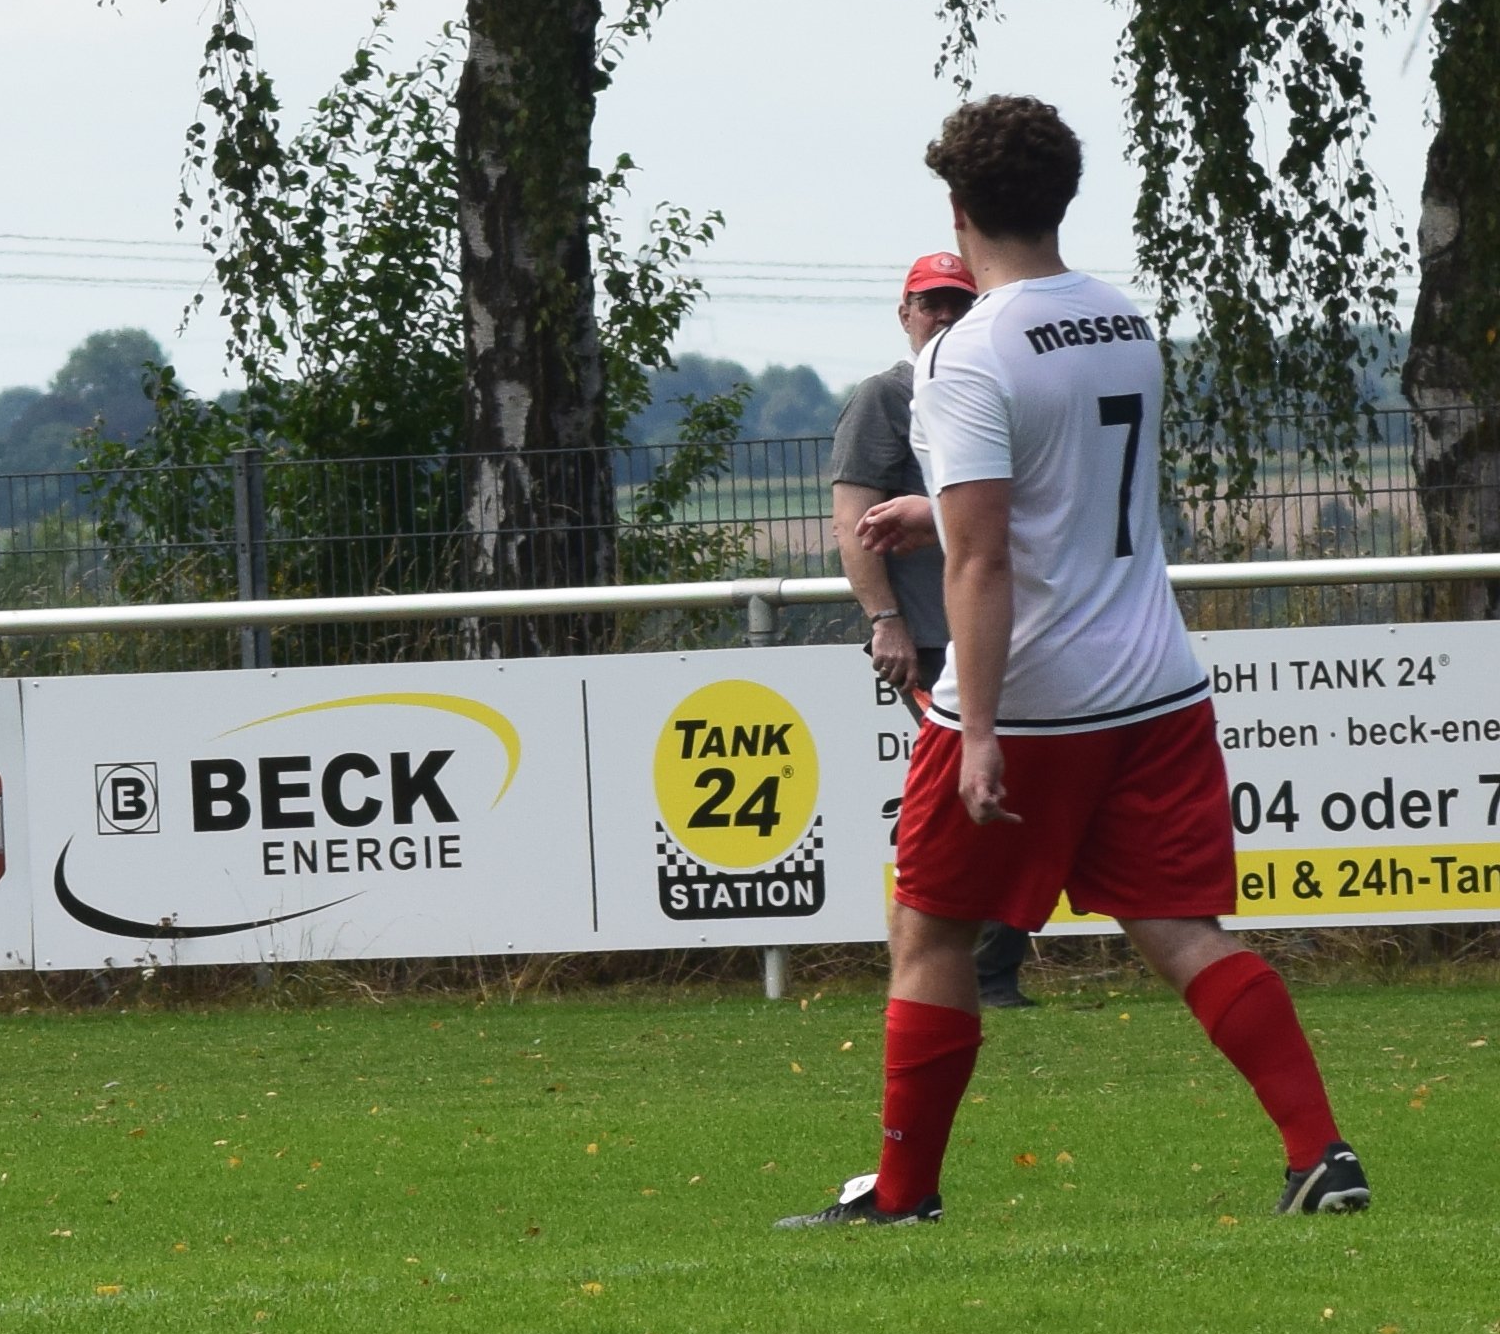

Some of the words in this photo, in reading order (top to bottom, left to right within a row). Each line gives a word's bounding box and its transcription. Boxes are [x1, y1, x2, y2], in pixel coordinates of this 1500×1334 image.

[1098, 393, 1143, 558] 7
[1212, 663, 1258, 694] bH
[1289, 657, 1386, 690] TANK
[674, 719, 794, 759] TANK
[1220, 719, 1318, 750] arben
[191, 750, 460, 833] BECK
[1321, 777, 1459, 833] oder
[262, 834, 464, 877] ENERGIE
[669, 880, 815, 910] STATION
[1292, 860, 1323, 899] &
